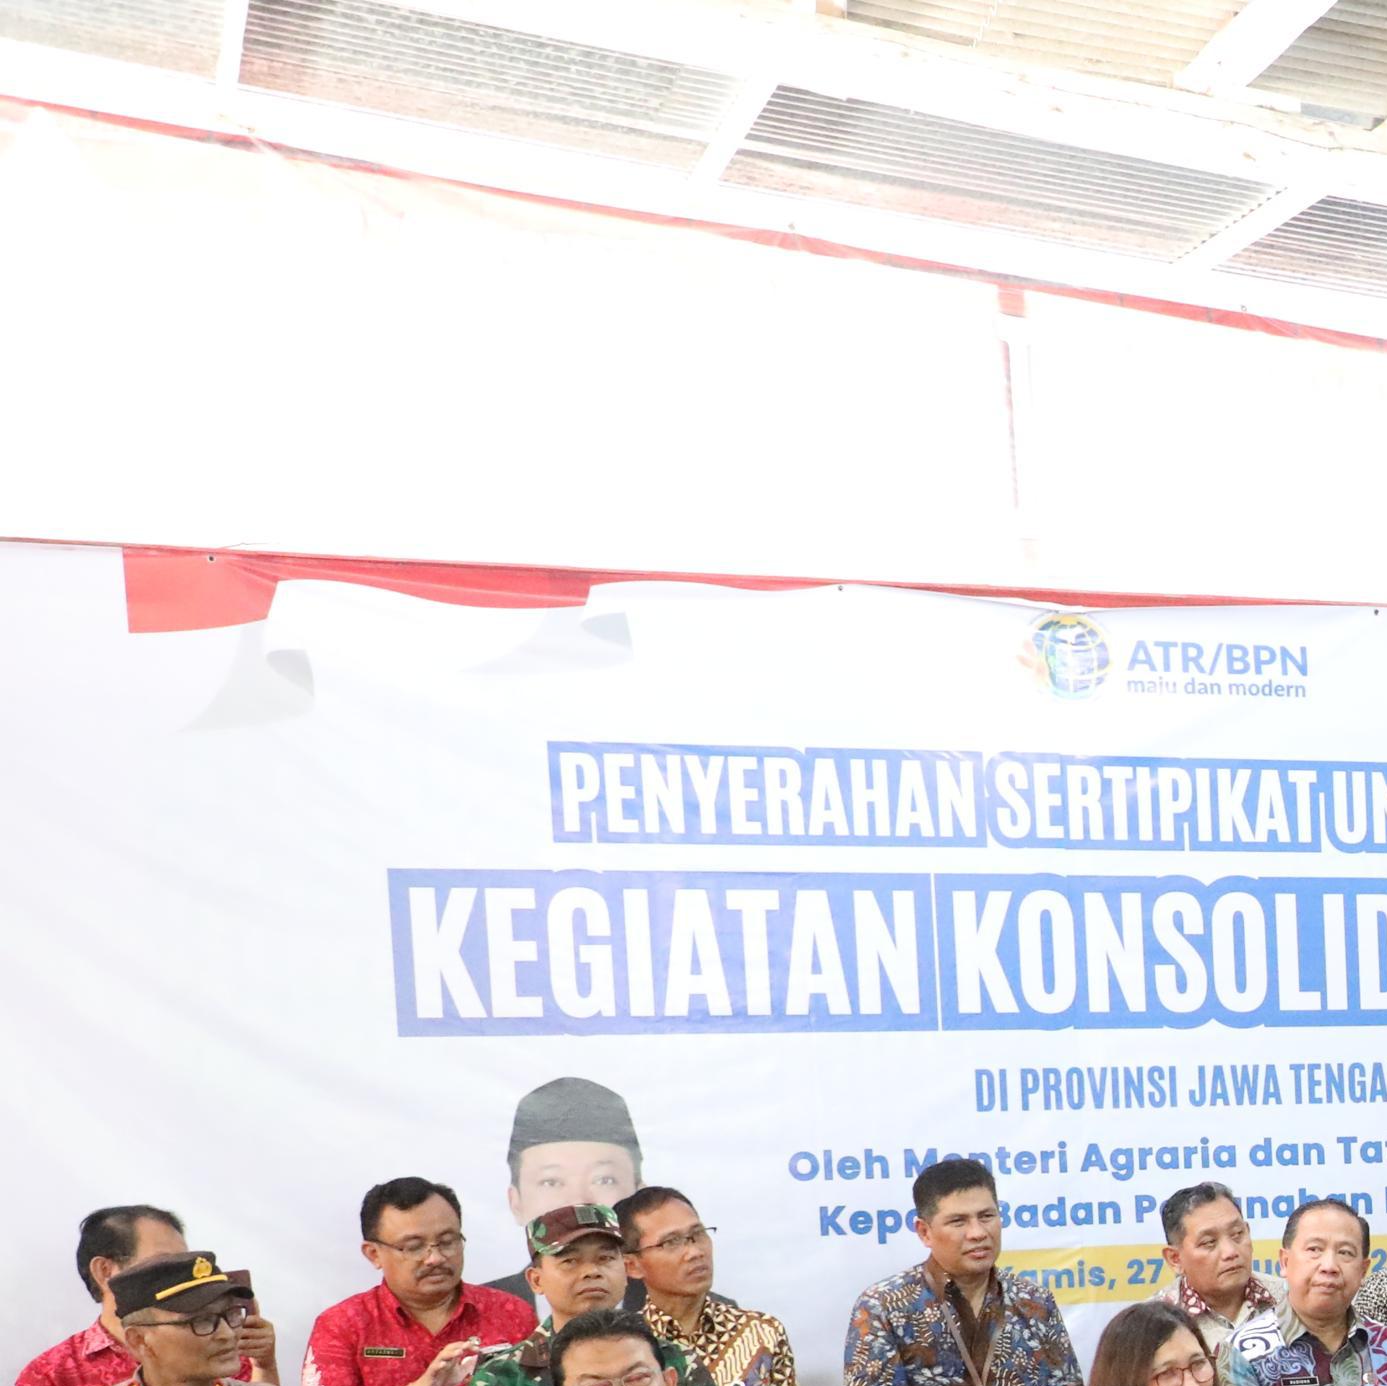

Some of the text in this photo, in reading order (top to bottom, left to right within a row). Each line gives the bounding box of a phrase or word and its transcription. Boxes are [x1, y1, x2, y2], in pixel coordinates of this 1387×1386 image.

[1127, 639, 1308, 677] ATR/BPN
[1127, 676, 1307, 698] maju dan modern
[558, 751, 979, 839] PENYERAHAN
[994, 759, 1324, 849] SERTIPIKAT
[407, 886, 921, 1019] KEGIATAN
[974, 1068, 1008, 1112] DI
[1020, 1065, 1178, 1111] PROVINSI
[1188, 1063, 1283, 1107] JAWA
[788, 1148, 890, 1182] Oleh
[903, 1140, 1068, 1178] Mnteri
[1080, 1136, 1237, 1182] Agraria
[1249, 1136, 1325, 1167] dan
[1126, 1258, 1165, 1285] 27
